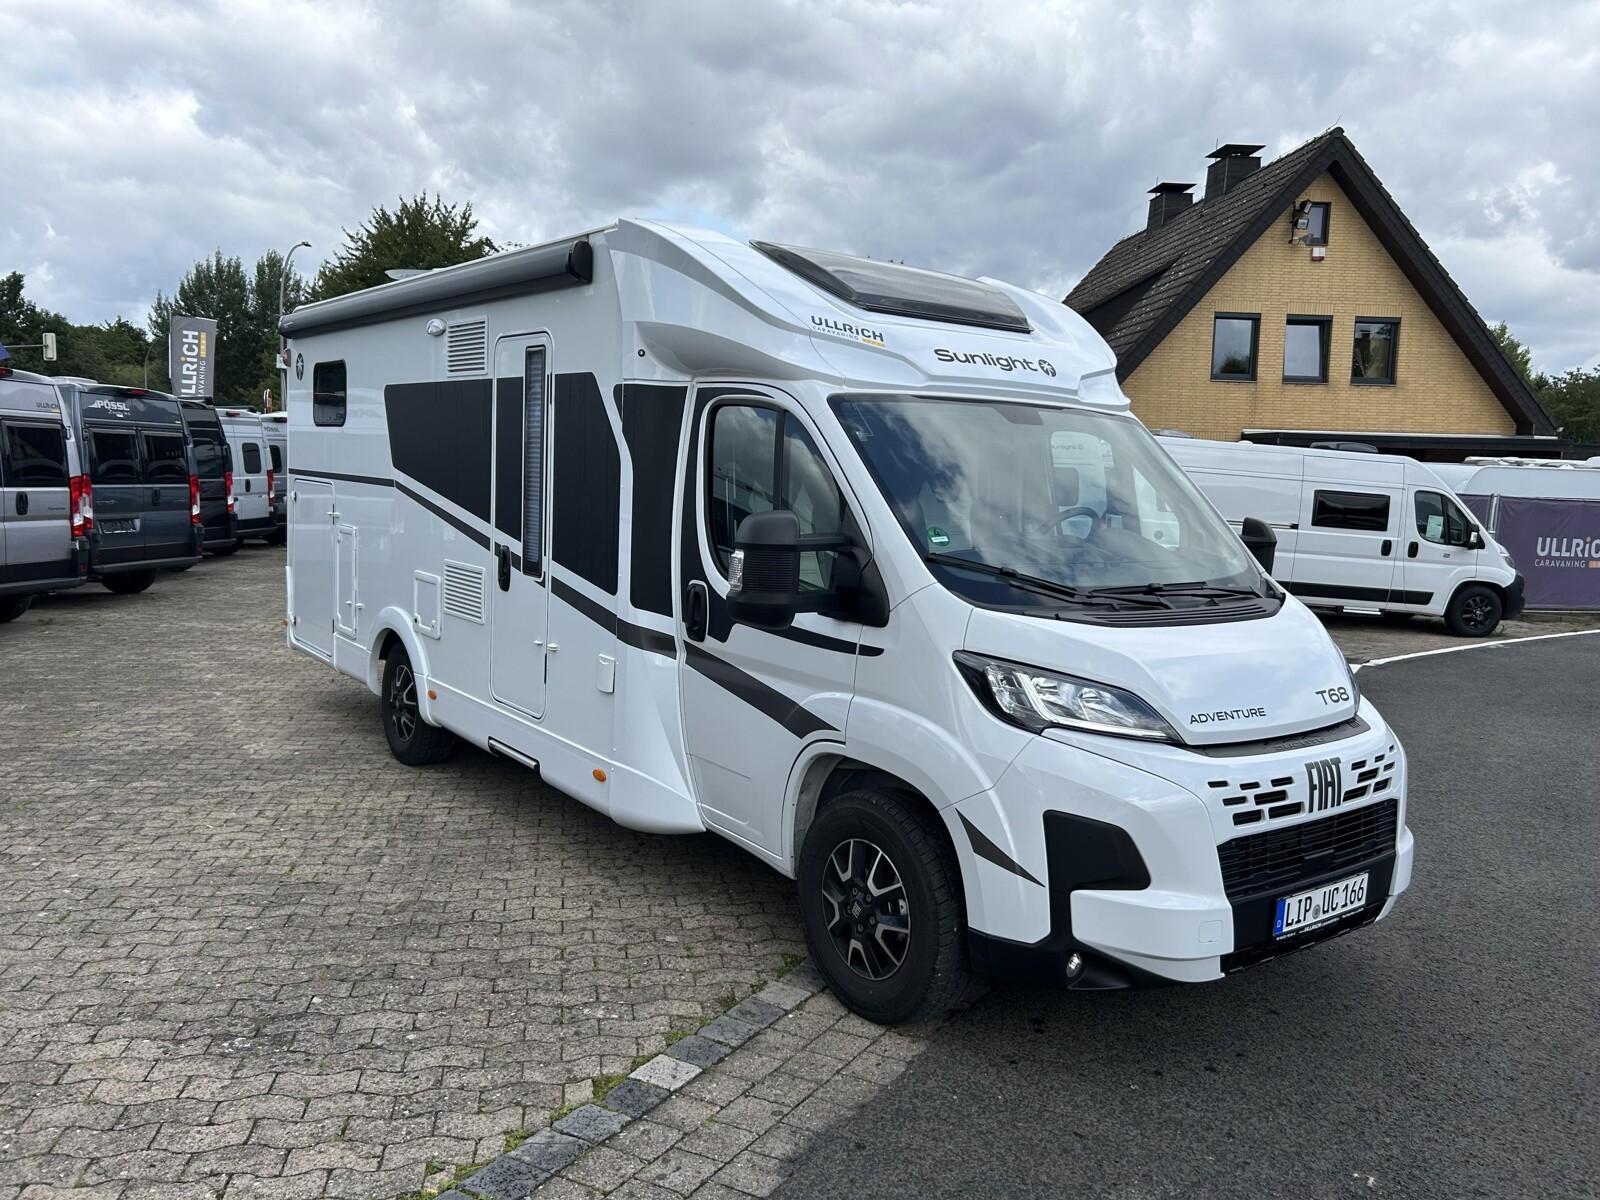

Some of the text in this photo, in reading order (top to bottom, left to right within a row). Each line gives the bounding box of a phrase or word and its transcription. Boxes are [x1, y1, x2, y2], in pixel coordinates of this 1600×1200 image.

[181, 330, 199, 397] LLRiCH
[934, 348, 1038, 372] Sunlight
[1536, 536, 1600, 558] ULLRiC
[1534, 559, 1586, 568] CARAVANING
[1315, 687, 1350, 705] T68
[1189, 707, 1267, 725] ADVENTURE
[1304, 756, 1342, 814] FIAT
[1285, 896, 1313, 928] LIP
